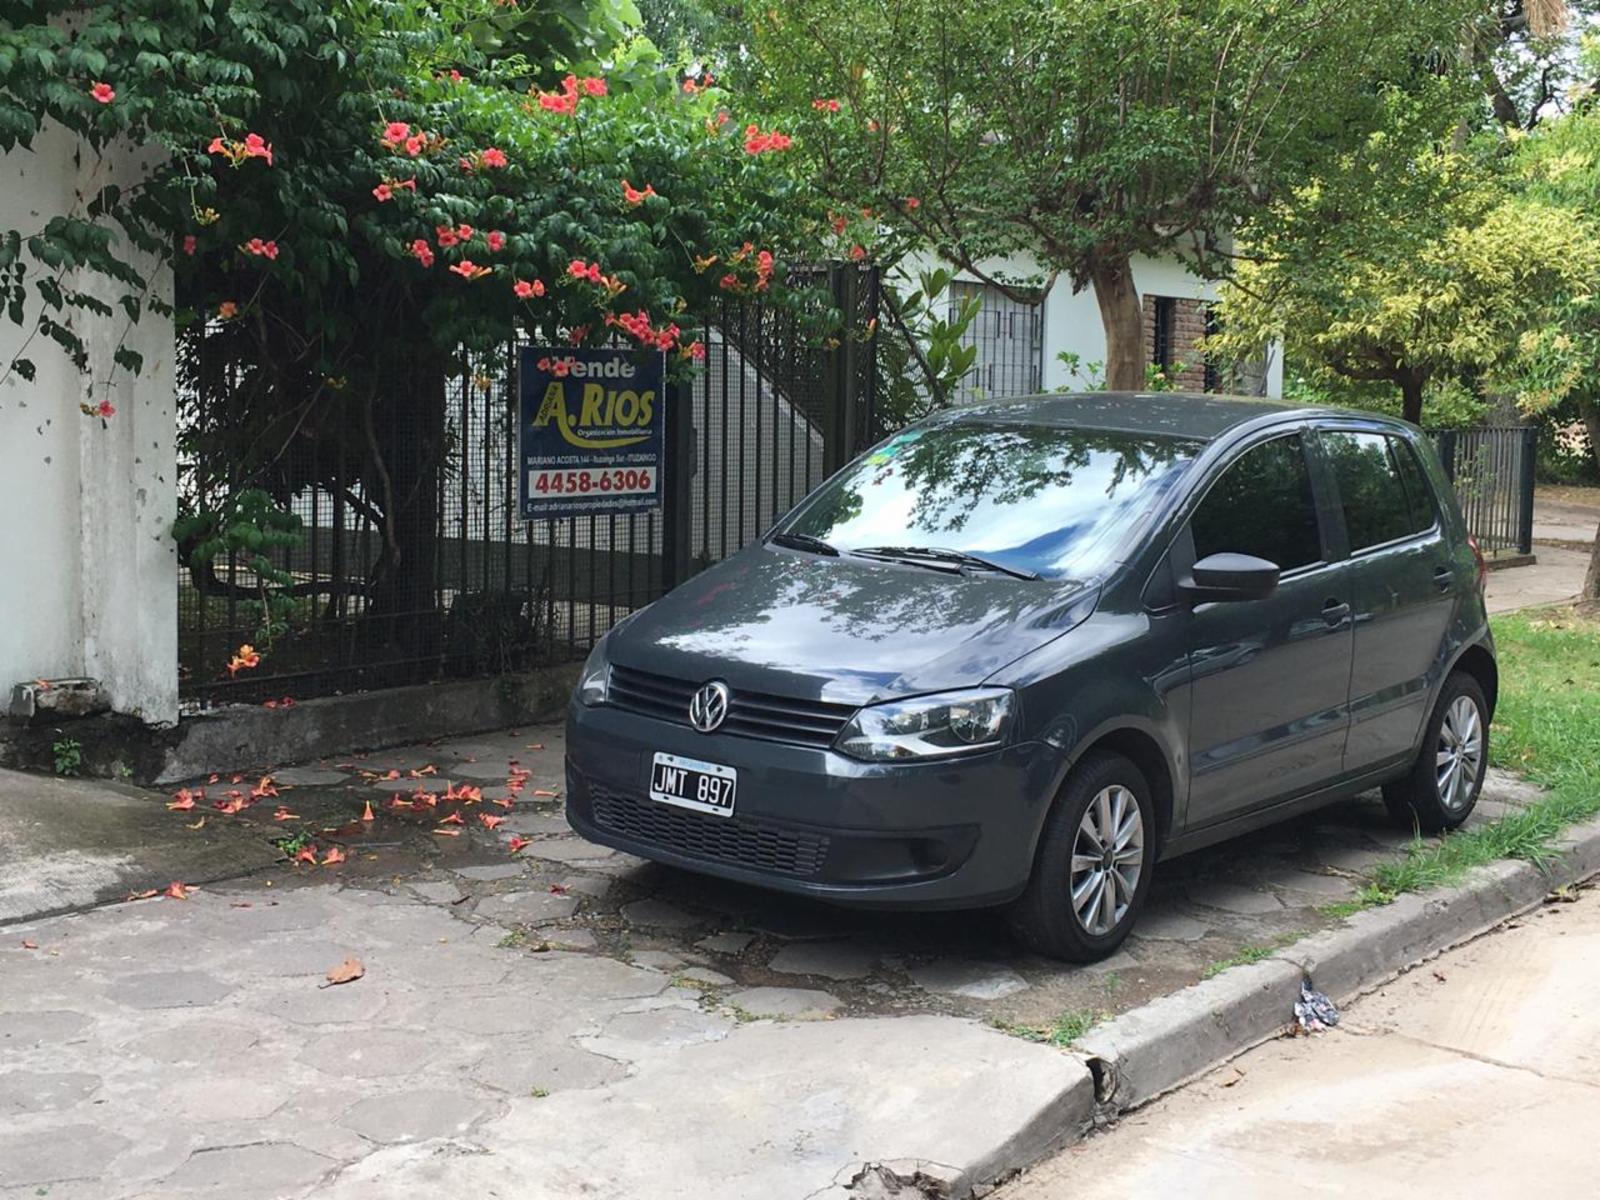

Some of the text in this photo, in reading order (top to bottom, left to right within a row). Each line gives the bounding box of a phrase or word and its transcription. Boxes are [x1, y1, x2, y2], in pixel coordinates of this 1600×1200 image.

[535, 469, 651, 493] 4458-6306
[655, 766, 732, 806] JMT 897
